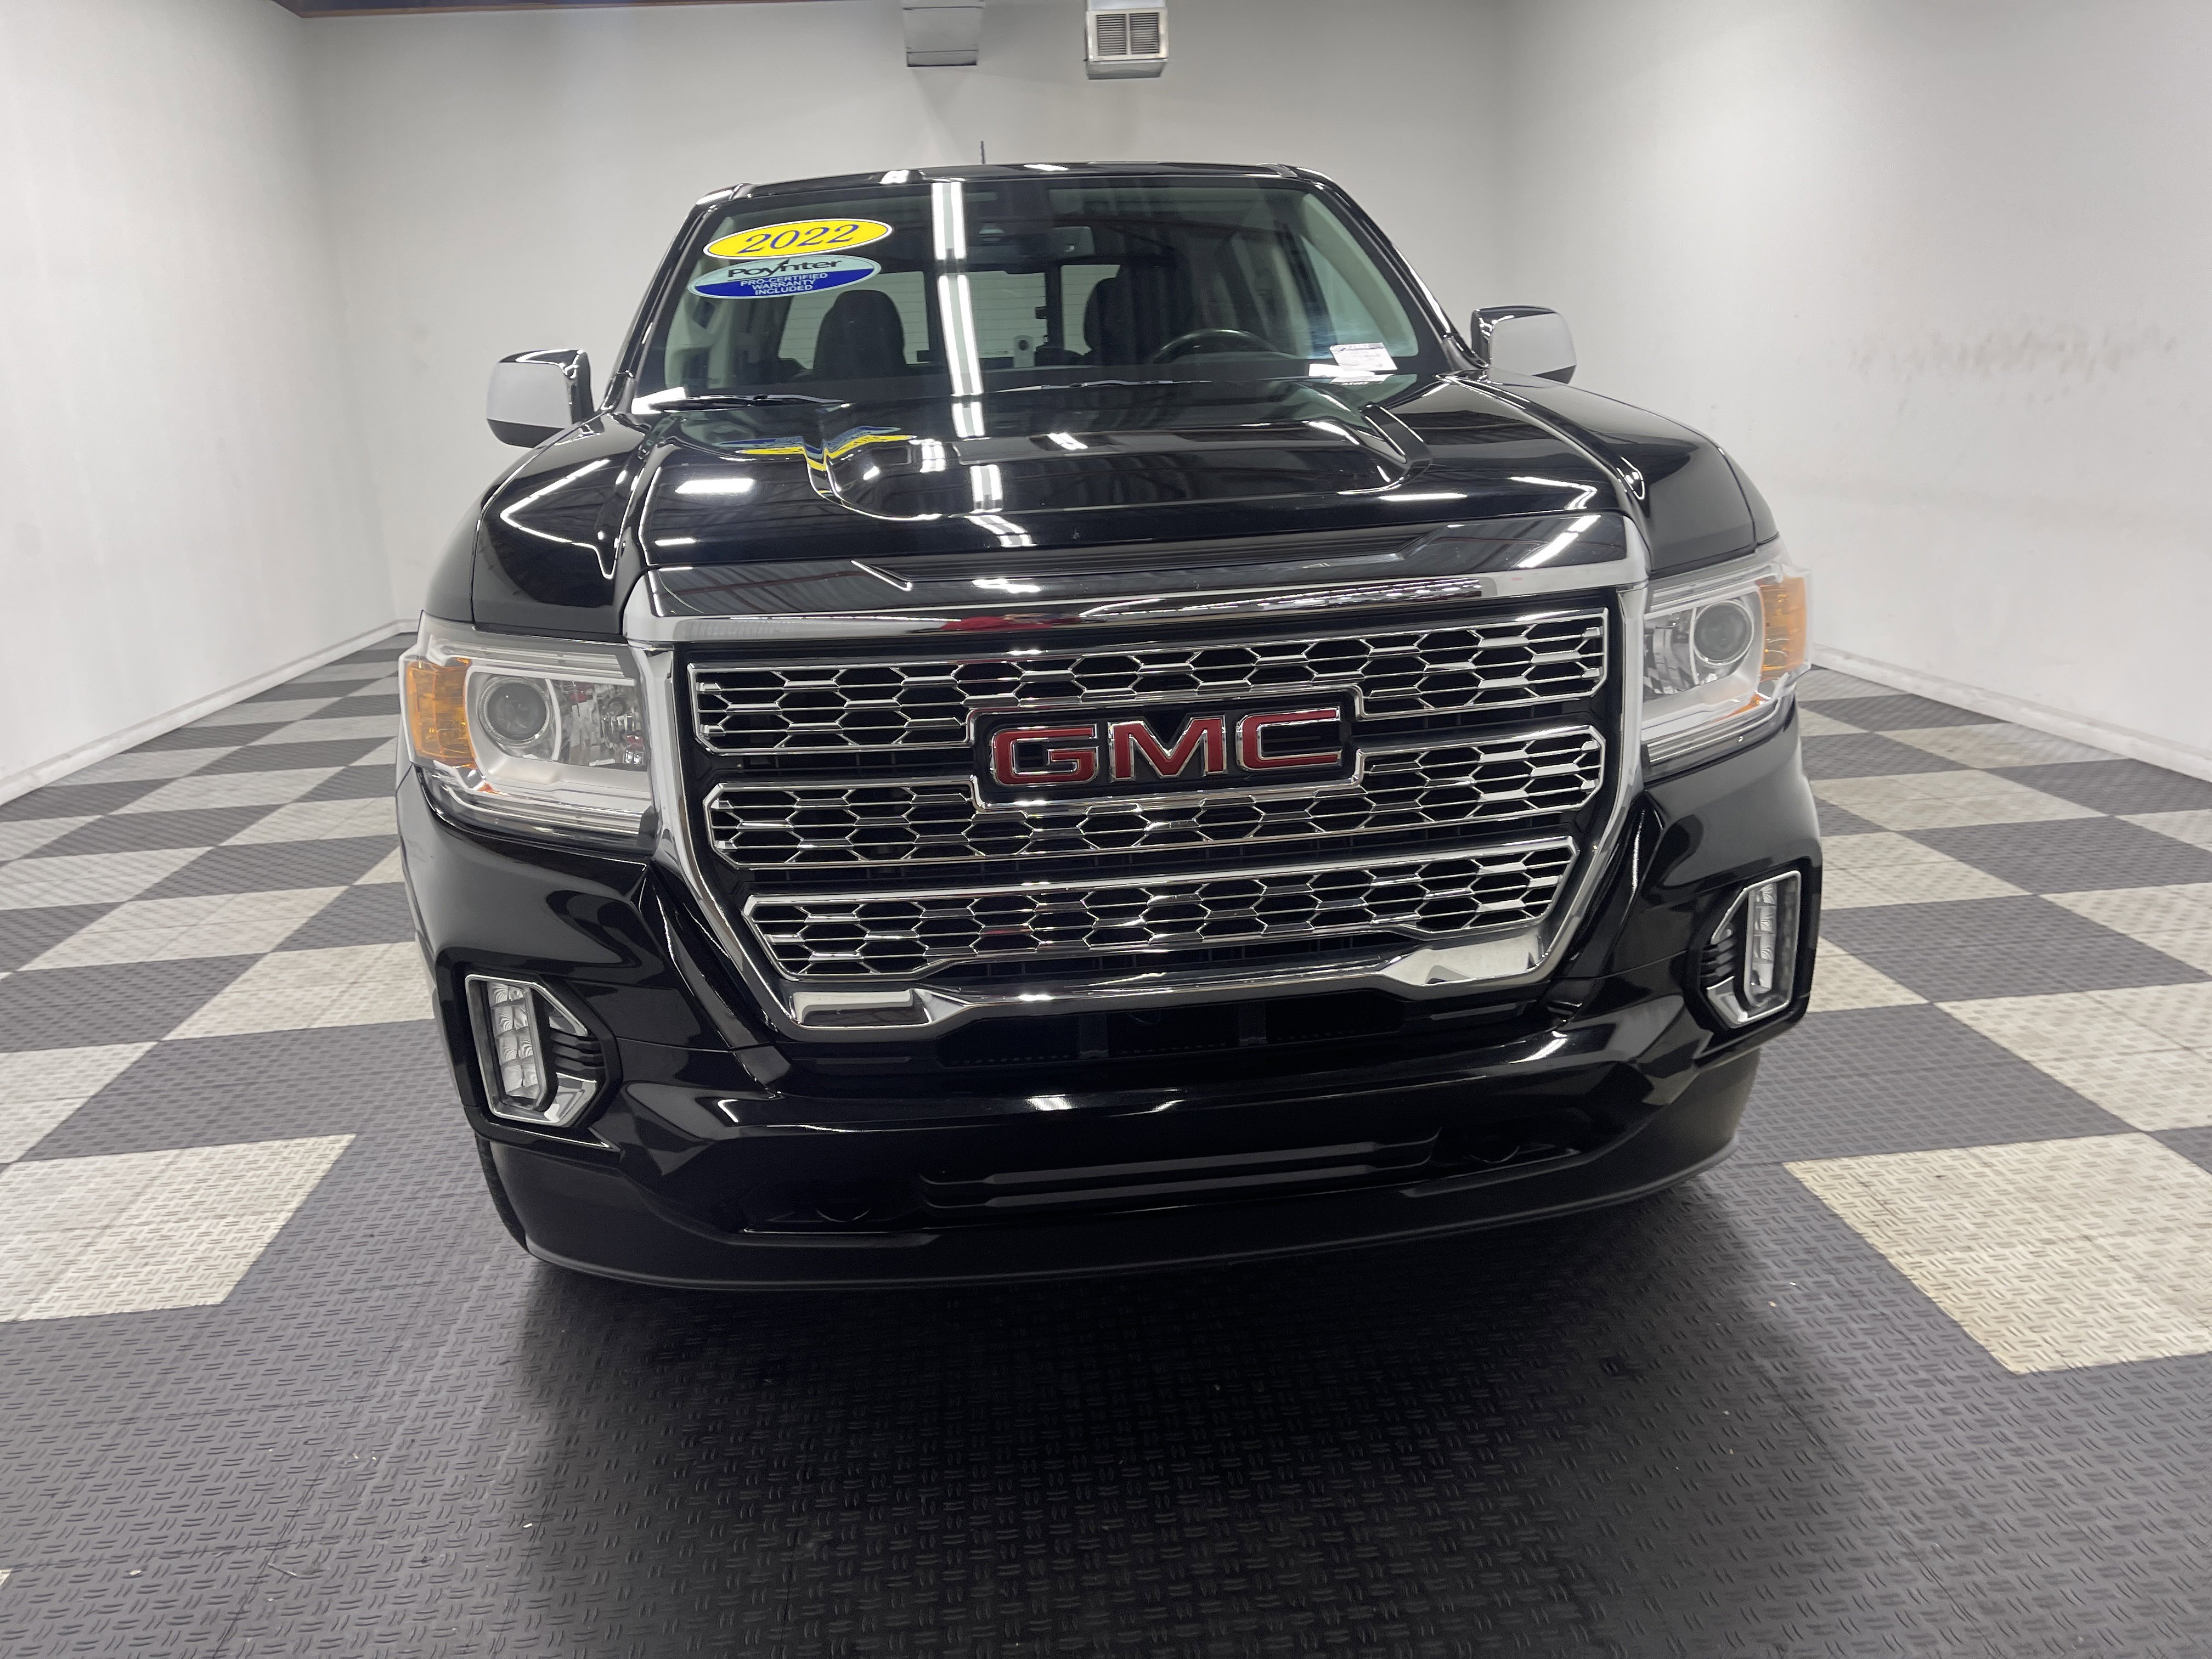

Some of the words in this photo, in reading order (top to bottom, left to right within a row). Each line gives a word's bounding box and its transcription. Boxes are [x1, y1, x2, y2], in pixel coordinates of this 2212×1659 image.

[737, 224, 859, 253] 2022
[727, 259, 842, 281] Poynter
[741, 273, 828, 286] PRO-CERTIFIED
[752, 279, 816, 290] WARRANTY
[755, 285, 813, 295] INCLUDED
[990, 706, 1342, 787] GMC
